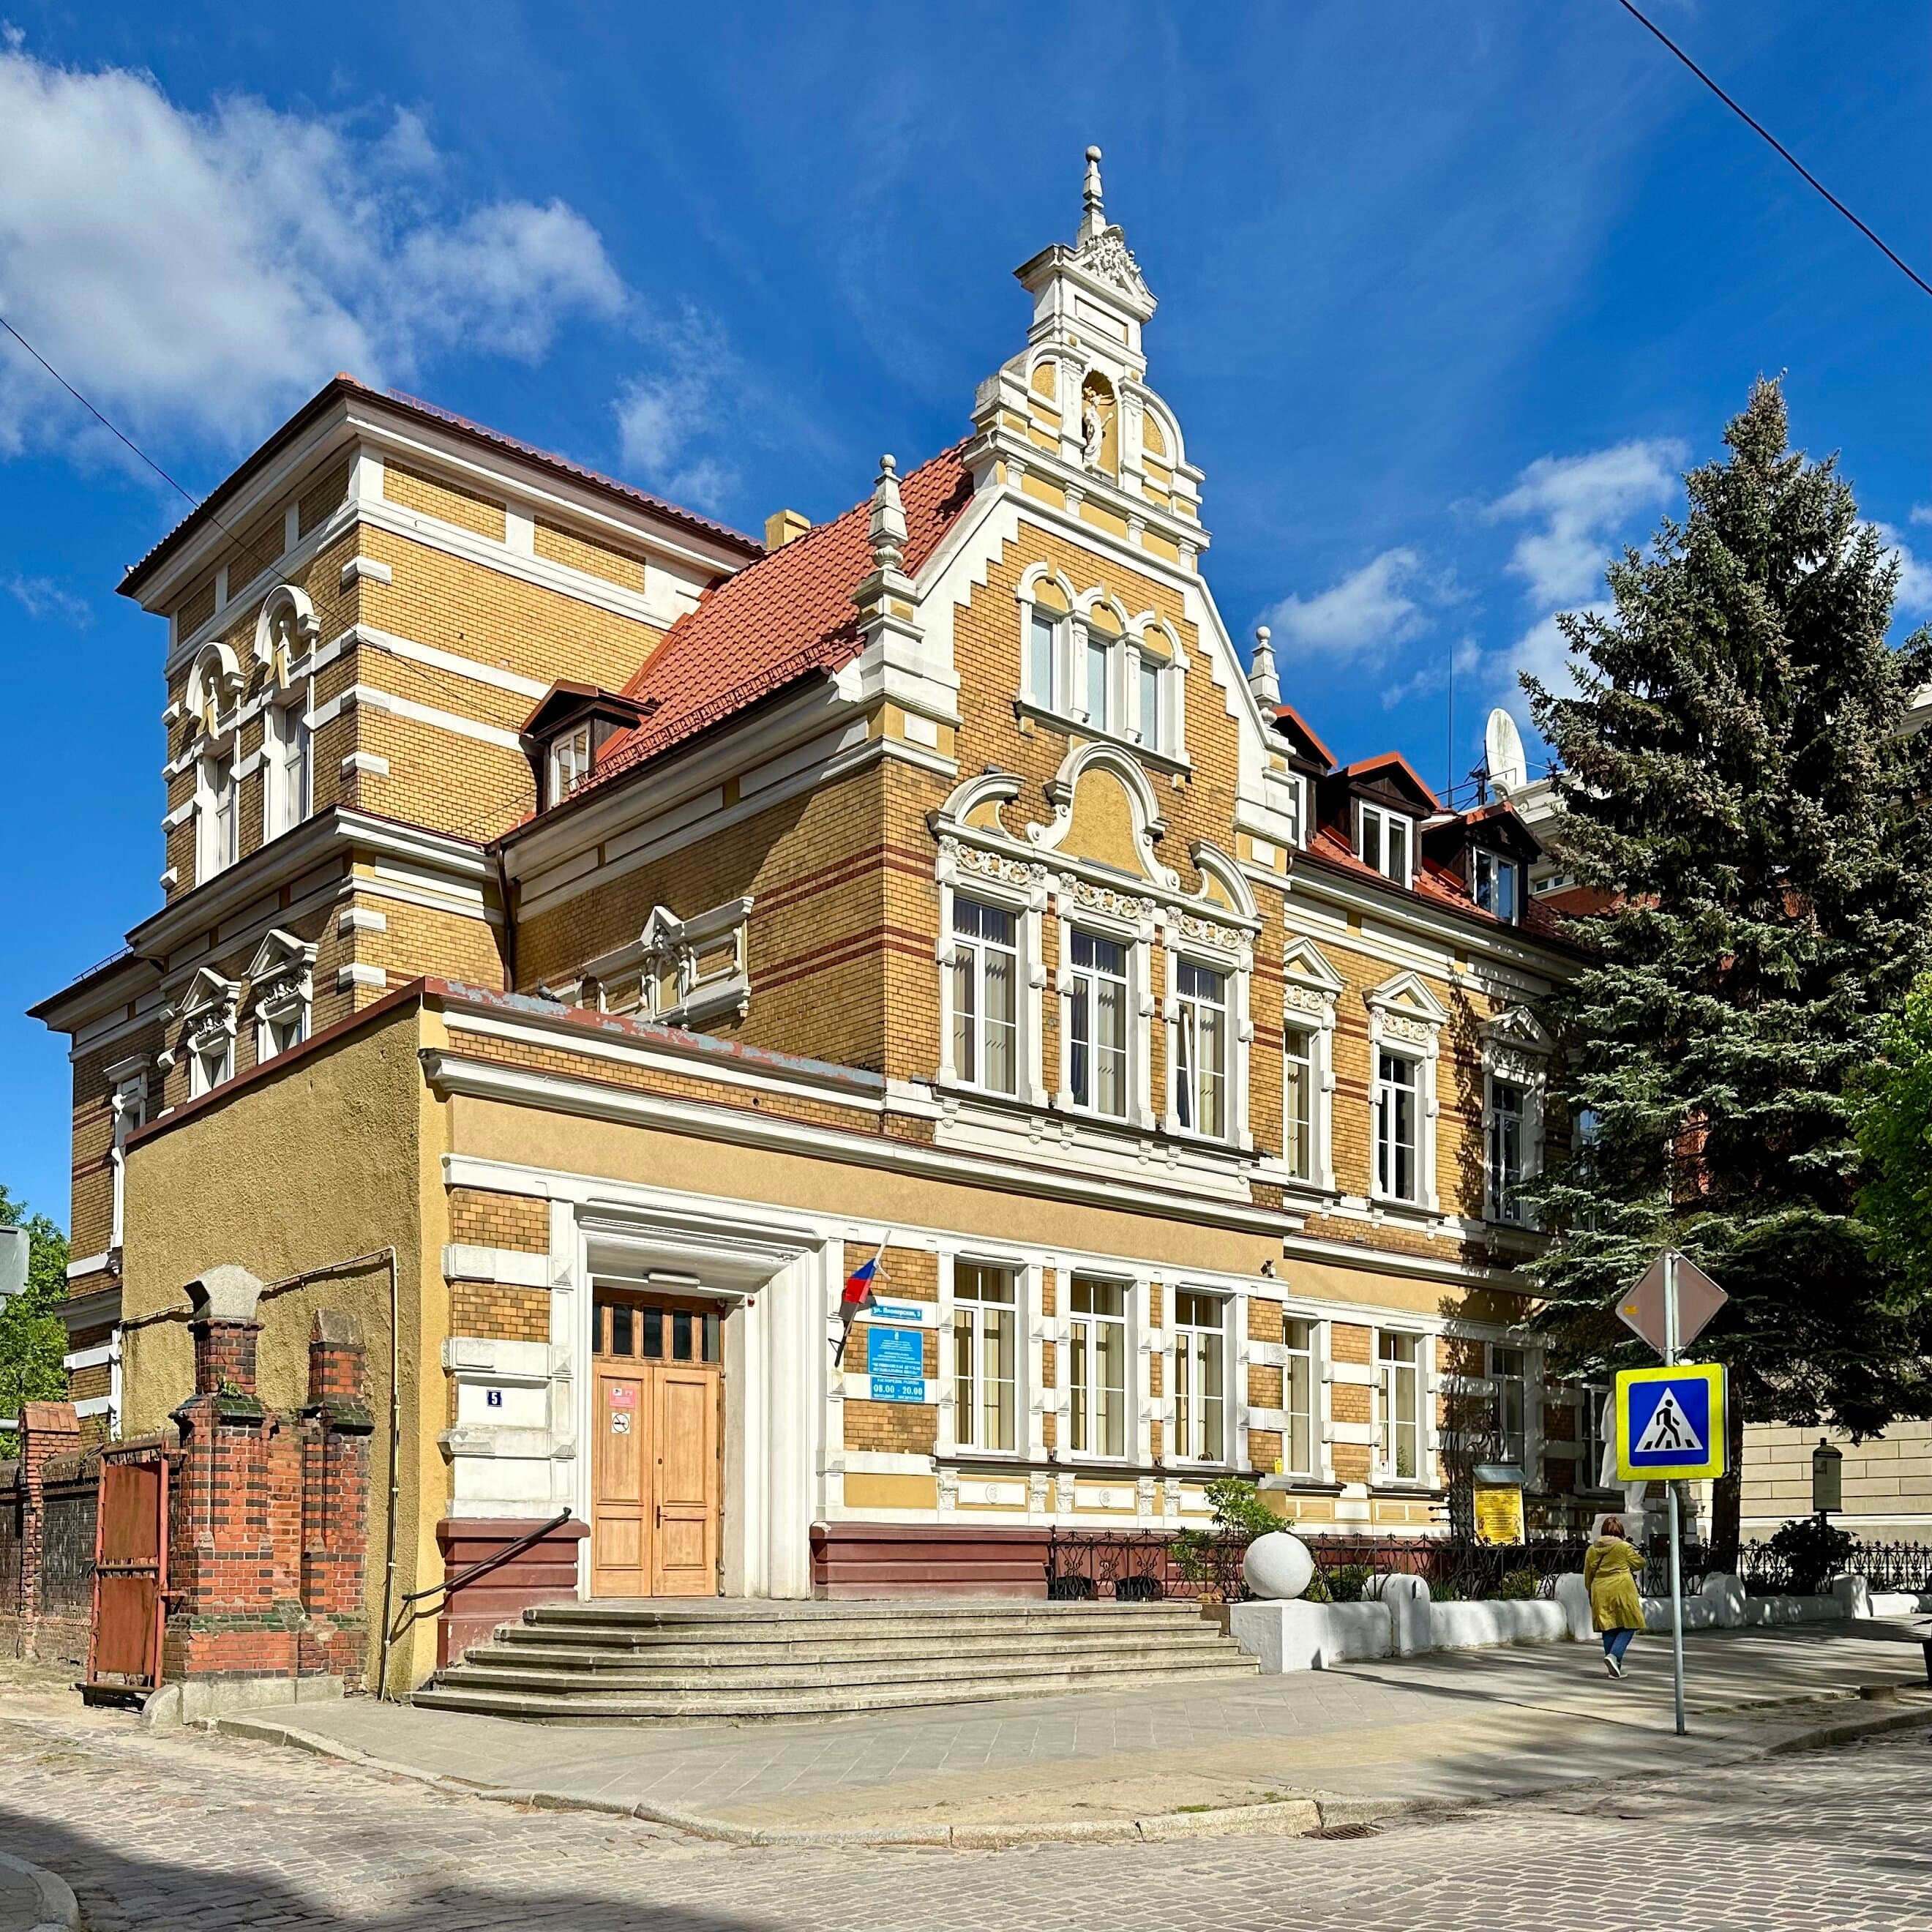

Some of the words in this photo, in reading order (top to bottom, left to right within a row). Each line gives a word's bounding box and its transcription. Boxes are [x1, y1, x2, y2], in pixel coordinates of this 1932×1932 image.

[873, 1384, 895, 1393] 08.00
[902, 1386, 923, 1396] 20.00
[491, 1392, 498, 1404] 5
